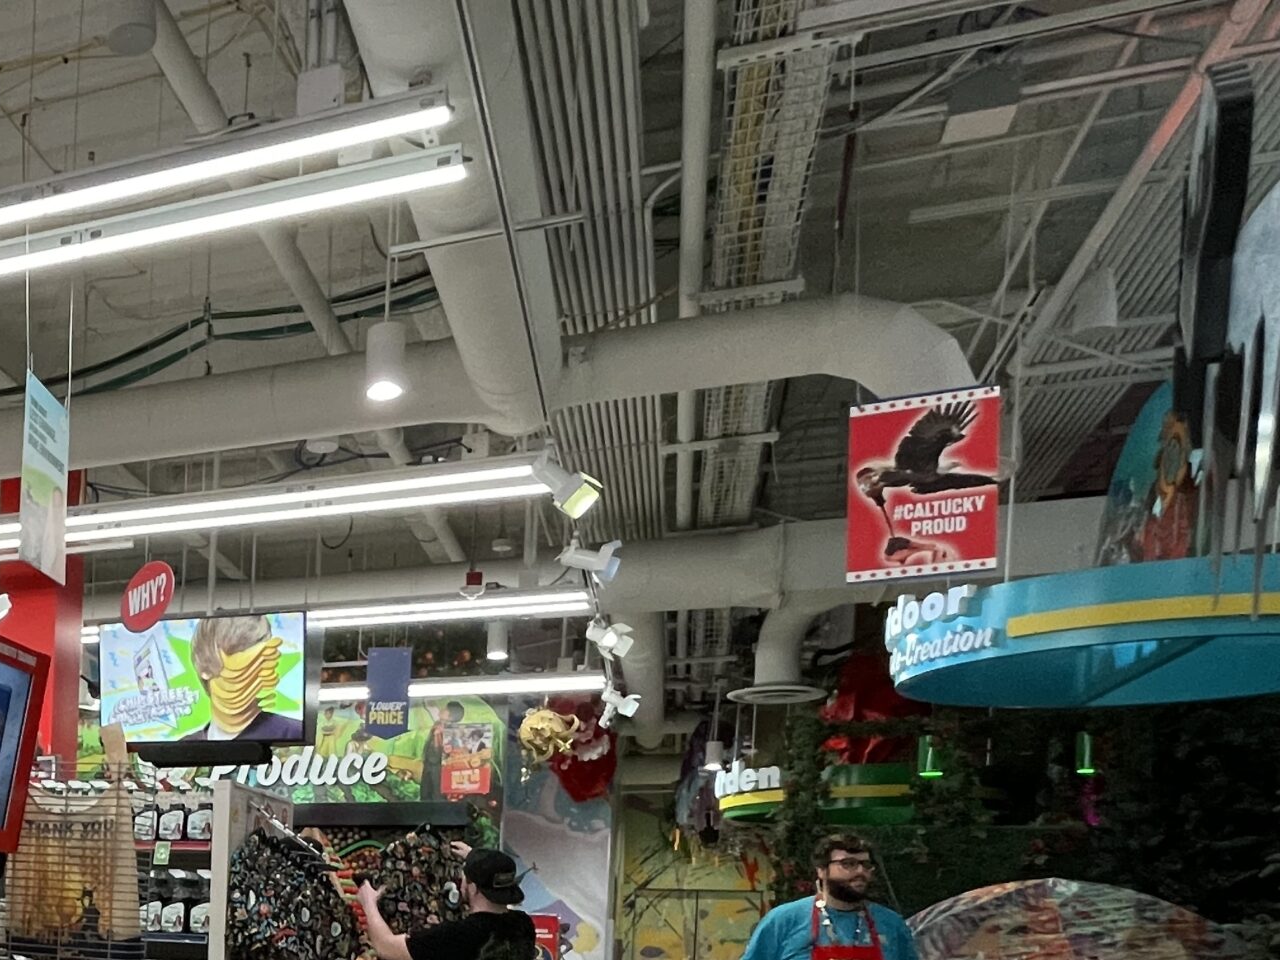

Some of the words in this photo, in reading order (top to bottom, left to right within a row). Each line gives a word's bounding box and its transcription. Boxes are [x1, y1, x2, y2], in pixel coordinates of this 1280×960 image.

[893, 495, 986, 520] #CALTUCKY
[911, 516, 967, 536] PROUD
[128, 572, 167, 617] WHY?
[368, 711, 404, 725] PRICE
